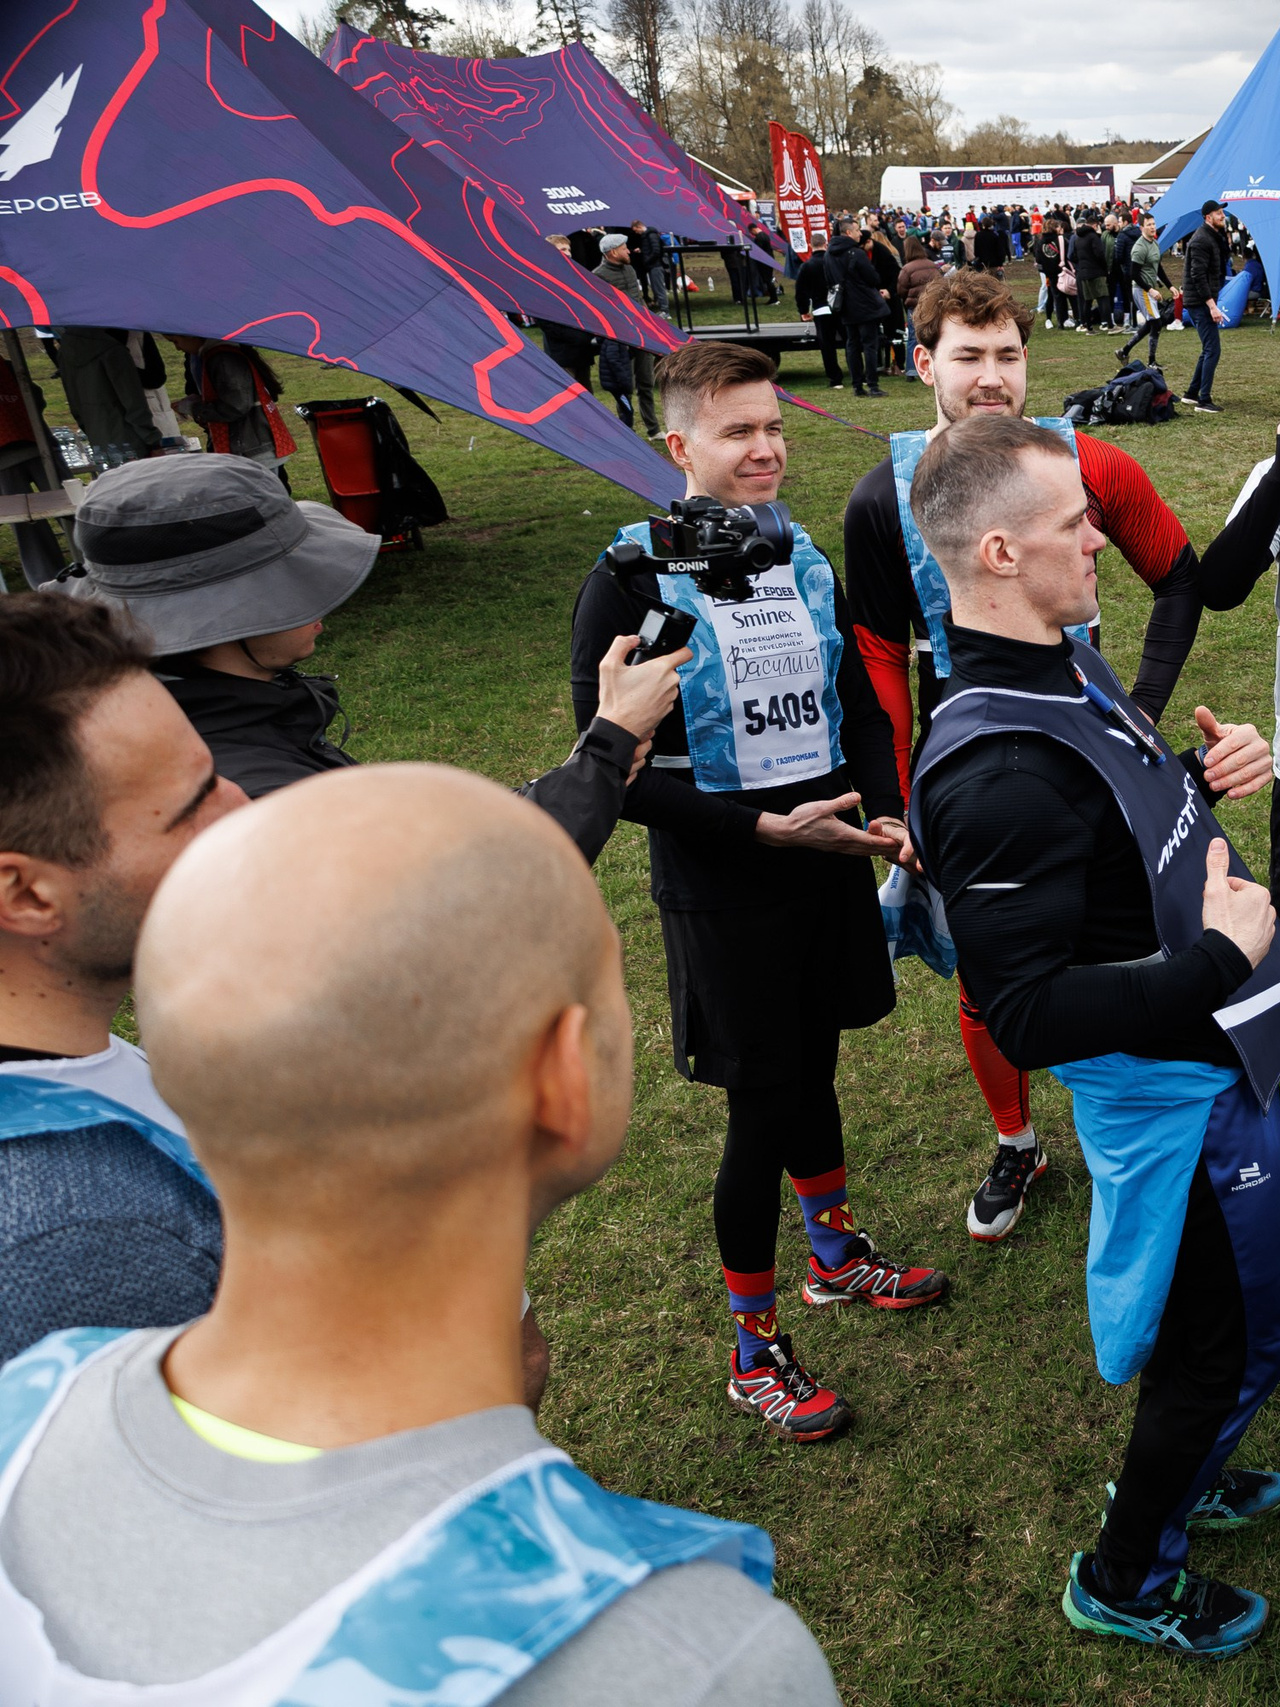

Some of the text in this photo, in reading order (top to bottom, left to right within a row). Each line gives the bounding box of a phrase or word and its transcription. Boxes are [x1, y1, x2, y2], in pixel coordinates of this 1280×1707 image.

[980, 172, 1053, 184] ГОНКА ГЕРОЕВ
[541, 186, 586, 199] ЗОНА
[1220, 190, 1247, 199] ГОНКА
[546, 200, 610, 216] ОТДЫХА
[668, 560, 710, 572] RONIN
[754, 586, 796, 598] ГЕРОЕВ
[731, 608, 796, 630] Sminex
[738, 632, 803, 645] ПЕРФЕКЦИОНИСТЫ
[758, 640, 804, 652] DEVELOPMENT
[743, 689, 820, 736] 5409
[776, 750, 820, 766] ГАЗПРОМБАНК
[1230, 1172, 1272, 1192] NORDSKI
